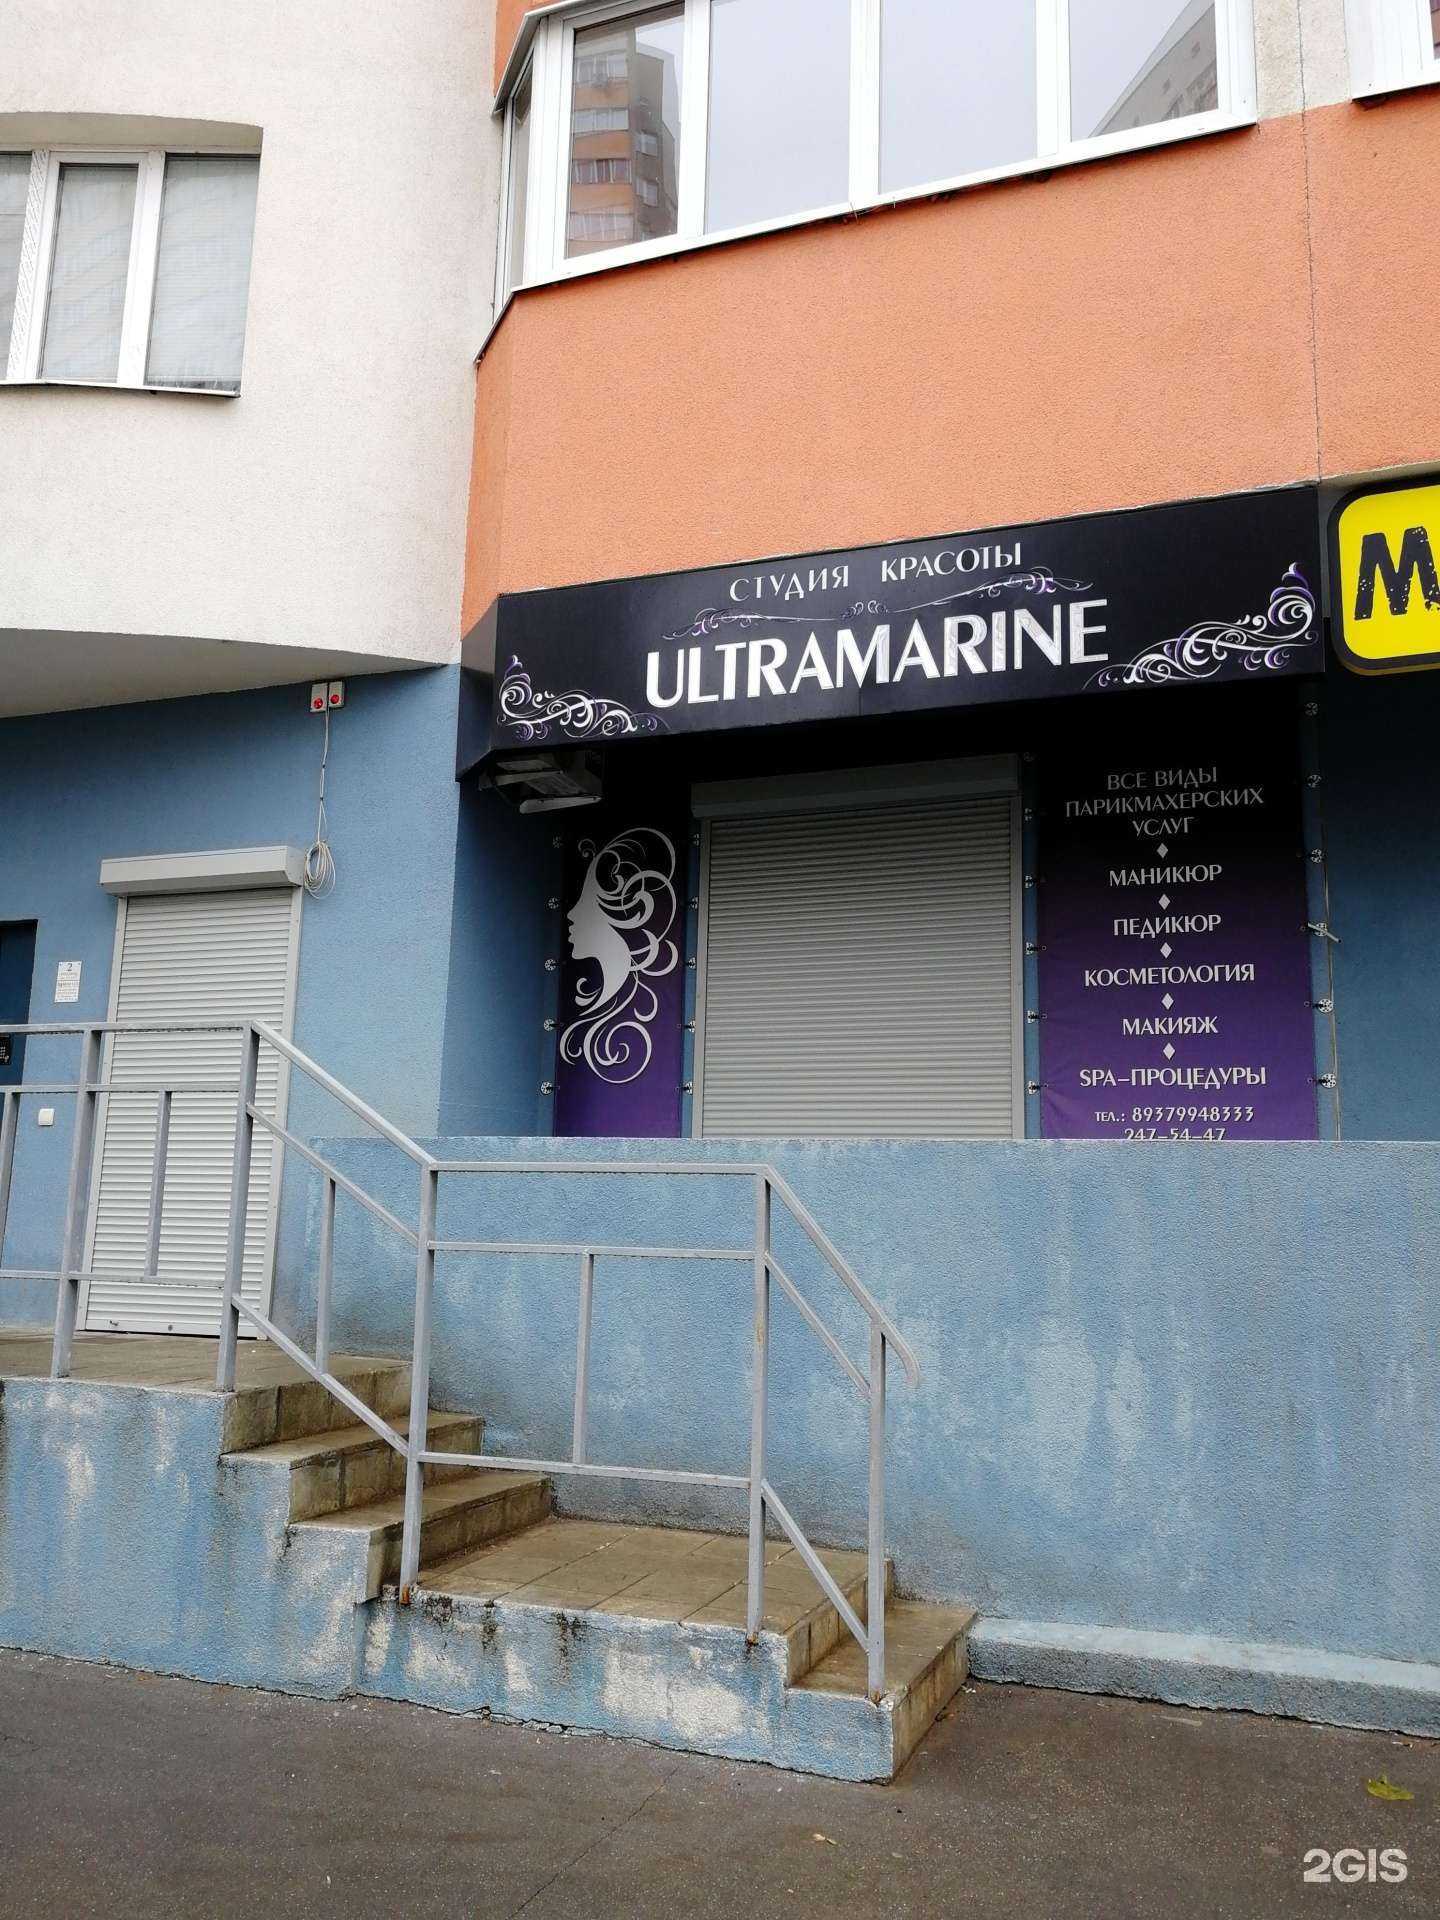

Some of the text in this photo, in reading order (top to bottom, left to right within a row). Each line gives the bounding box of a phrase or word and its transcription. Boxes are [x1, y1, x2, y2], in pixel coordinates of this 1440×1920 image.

[729, 542, 1022, 601] СТУДИЯ КРАСОТЫ
[646, 598, 1110, 709] ULTRAMARINE
[1107, 766, 1217, 790] ВСЕ ВИДЫ
[1065, 787, 1264, 817] ПАРИКМАХЕРСКИХ
[1132, 816, 1195, 837] УСЛУГ
[1109, 864, 1222, 887] МАНИКЮР
[1113, 914, 1221, 939] ПЕДИКЮР
[1084, 964, 1255, 987] КОСМЕТОЛОГИЯ
[1122, 1016, 1218, 1036] МАКИЯЖ
[1079, 1067, 1266, 1089] SPA-ПРОЦЕДУРЫ
[1132, 1106, 1254, 1122] 89379948333
